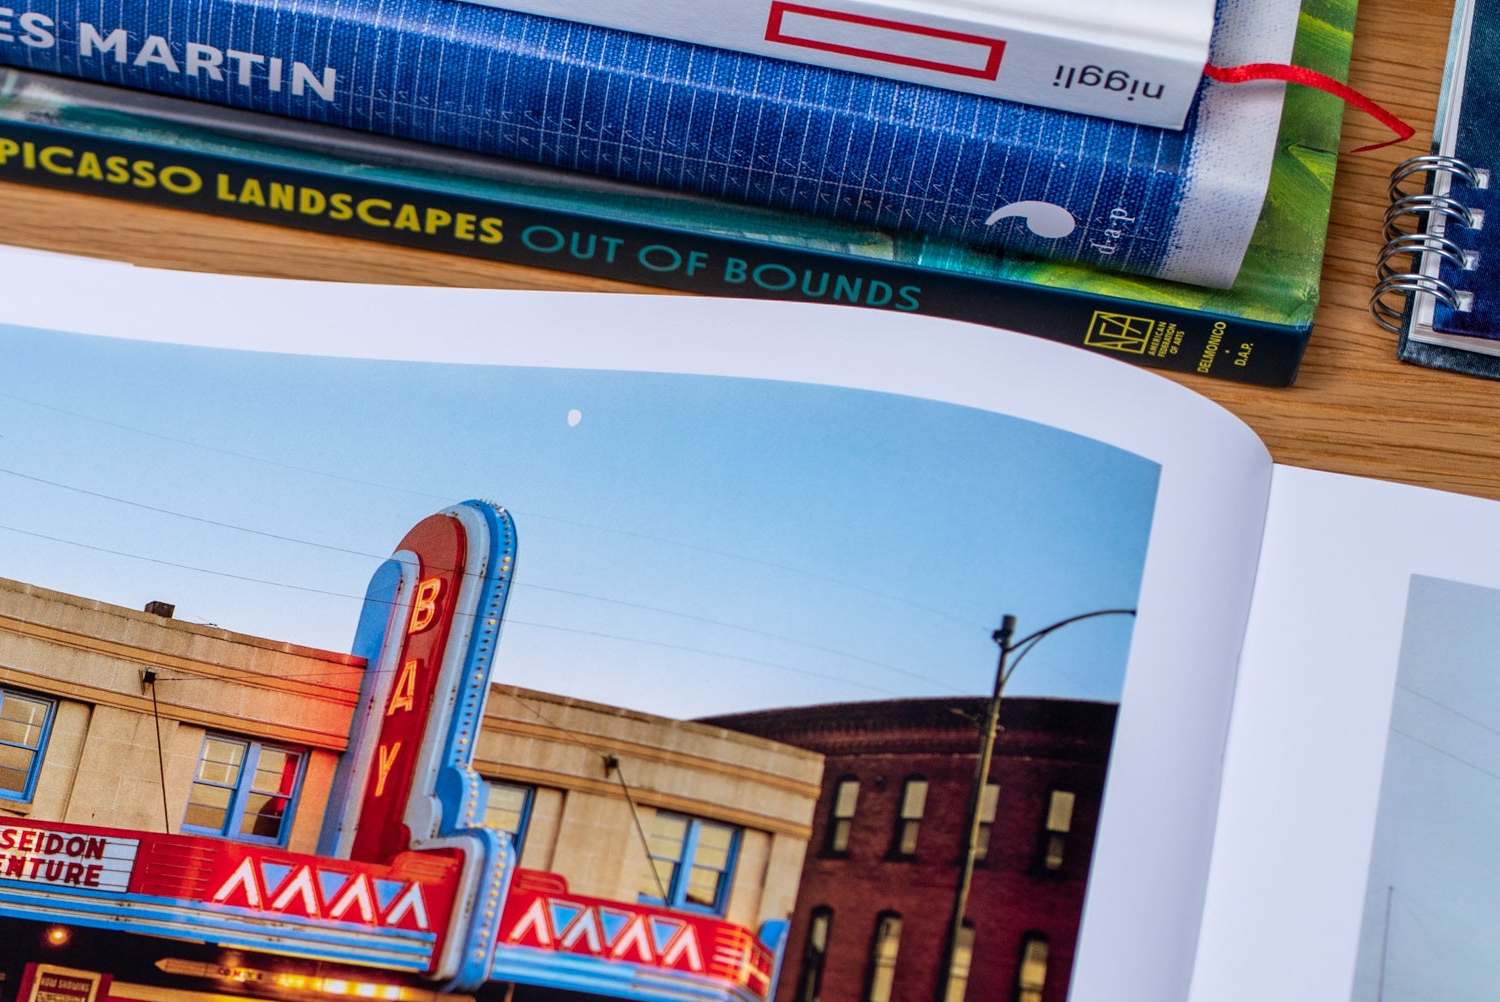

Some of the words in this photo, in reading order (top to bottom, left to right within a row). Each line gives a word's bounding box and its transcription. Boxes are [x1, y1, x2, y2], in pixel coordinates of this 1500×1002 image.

[80, 22, 337, 102] MARTIN
[1053, 64, 1165, 101] niggli
[216, 172, 505, 245] LANDSCAPES
[520, 225, 625, 264] OUT
[637, 244, 709, 277] OF
[723, 257, 923, 311] BOUNDS
[1148, 321, 1167, 356] AMERICAN
[1158, 323, 1177, 358] FEDERATION
[1169, 345, 1179, 354] OF
[1173, 330, 1185, 346] ARTS
[1197, 321, 1227, 374] DELMONICO
[1234, 342, 1254, 367] D.A.P.
[374, 577, 442, 797] BAY
